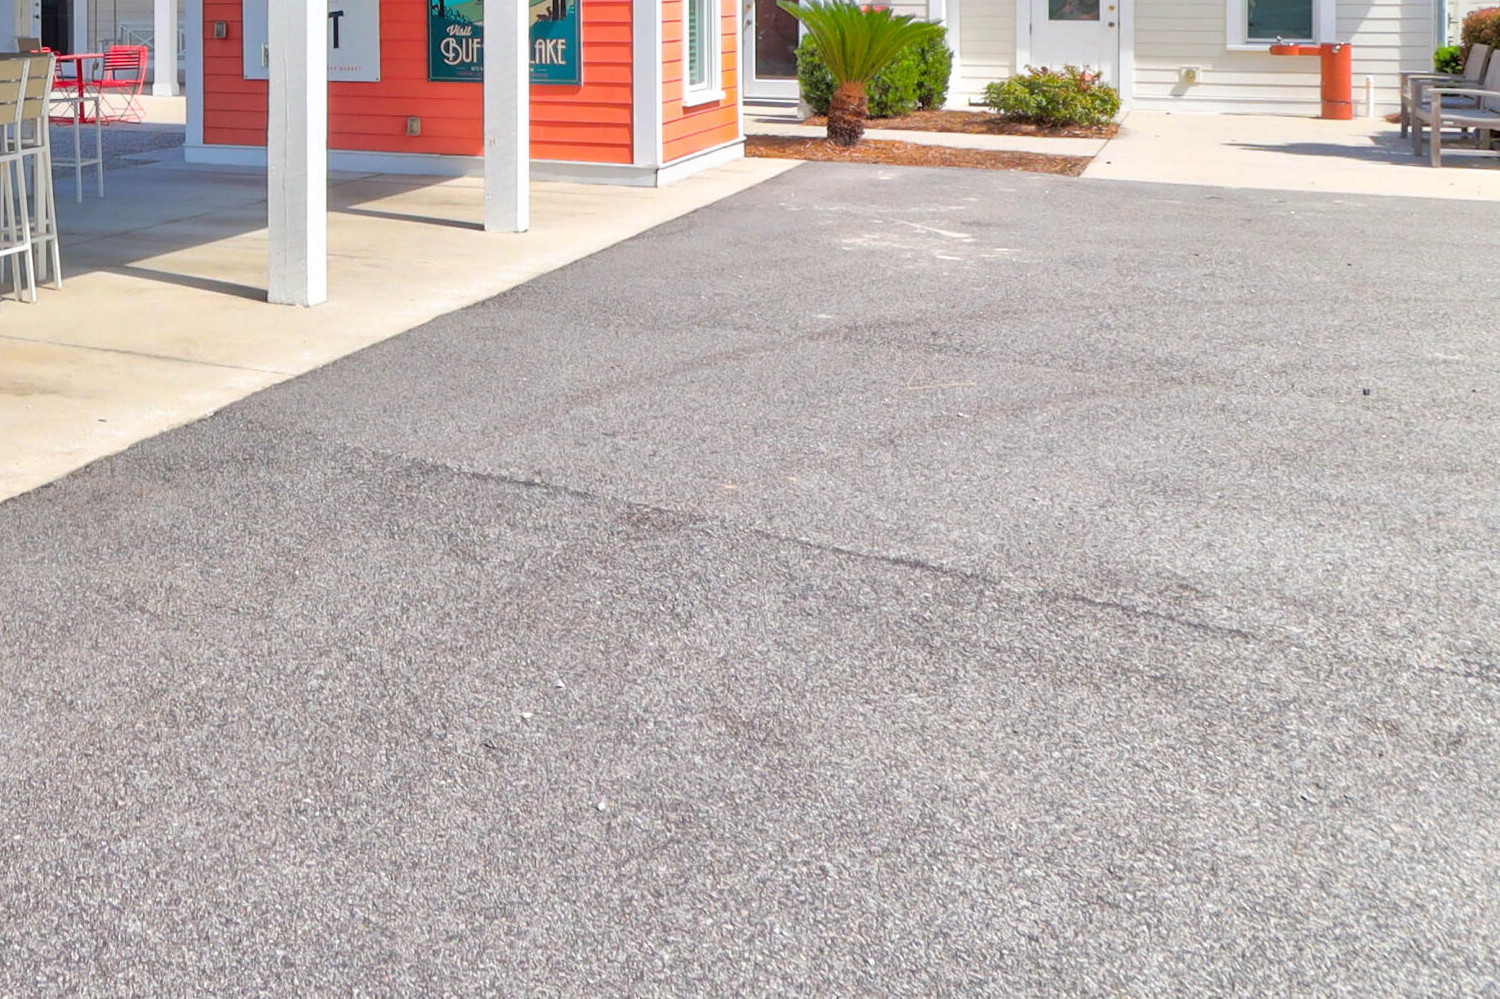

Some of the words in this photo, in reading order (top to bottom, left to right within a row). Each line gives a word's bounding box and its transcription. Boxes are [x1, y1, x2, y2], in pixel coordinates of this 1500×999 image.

[446, 24, 473, 36] Visit
[440, 37, 483, 65] BUF
[529, 38, 566, 64] AKE
